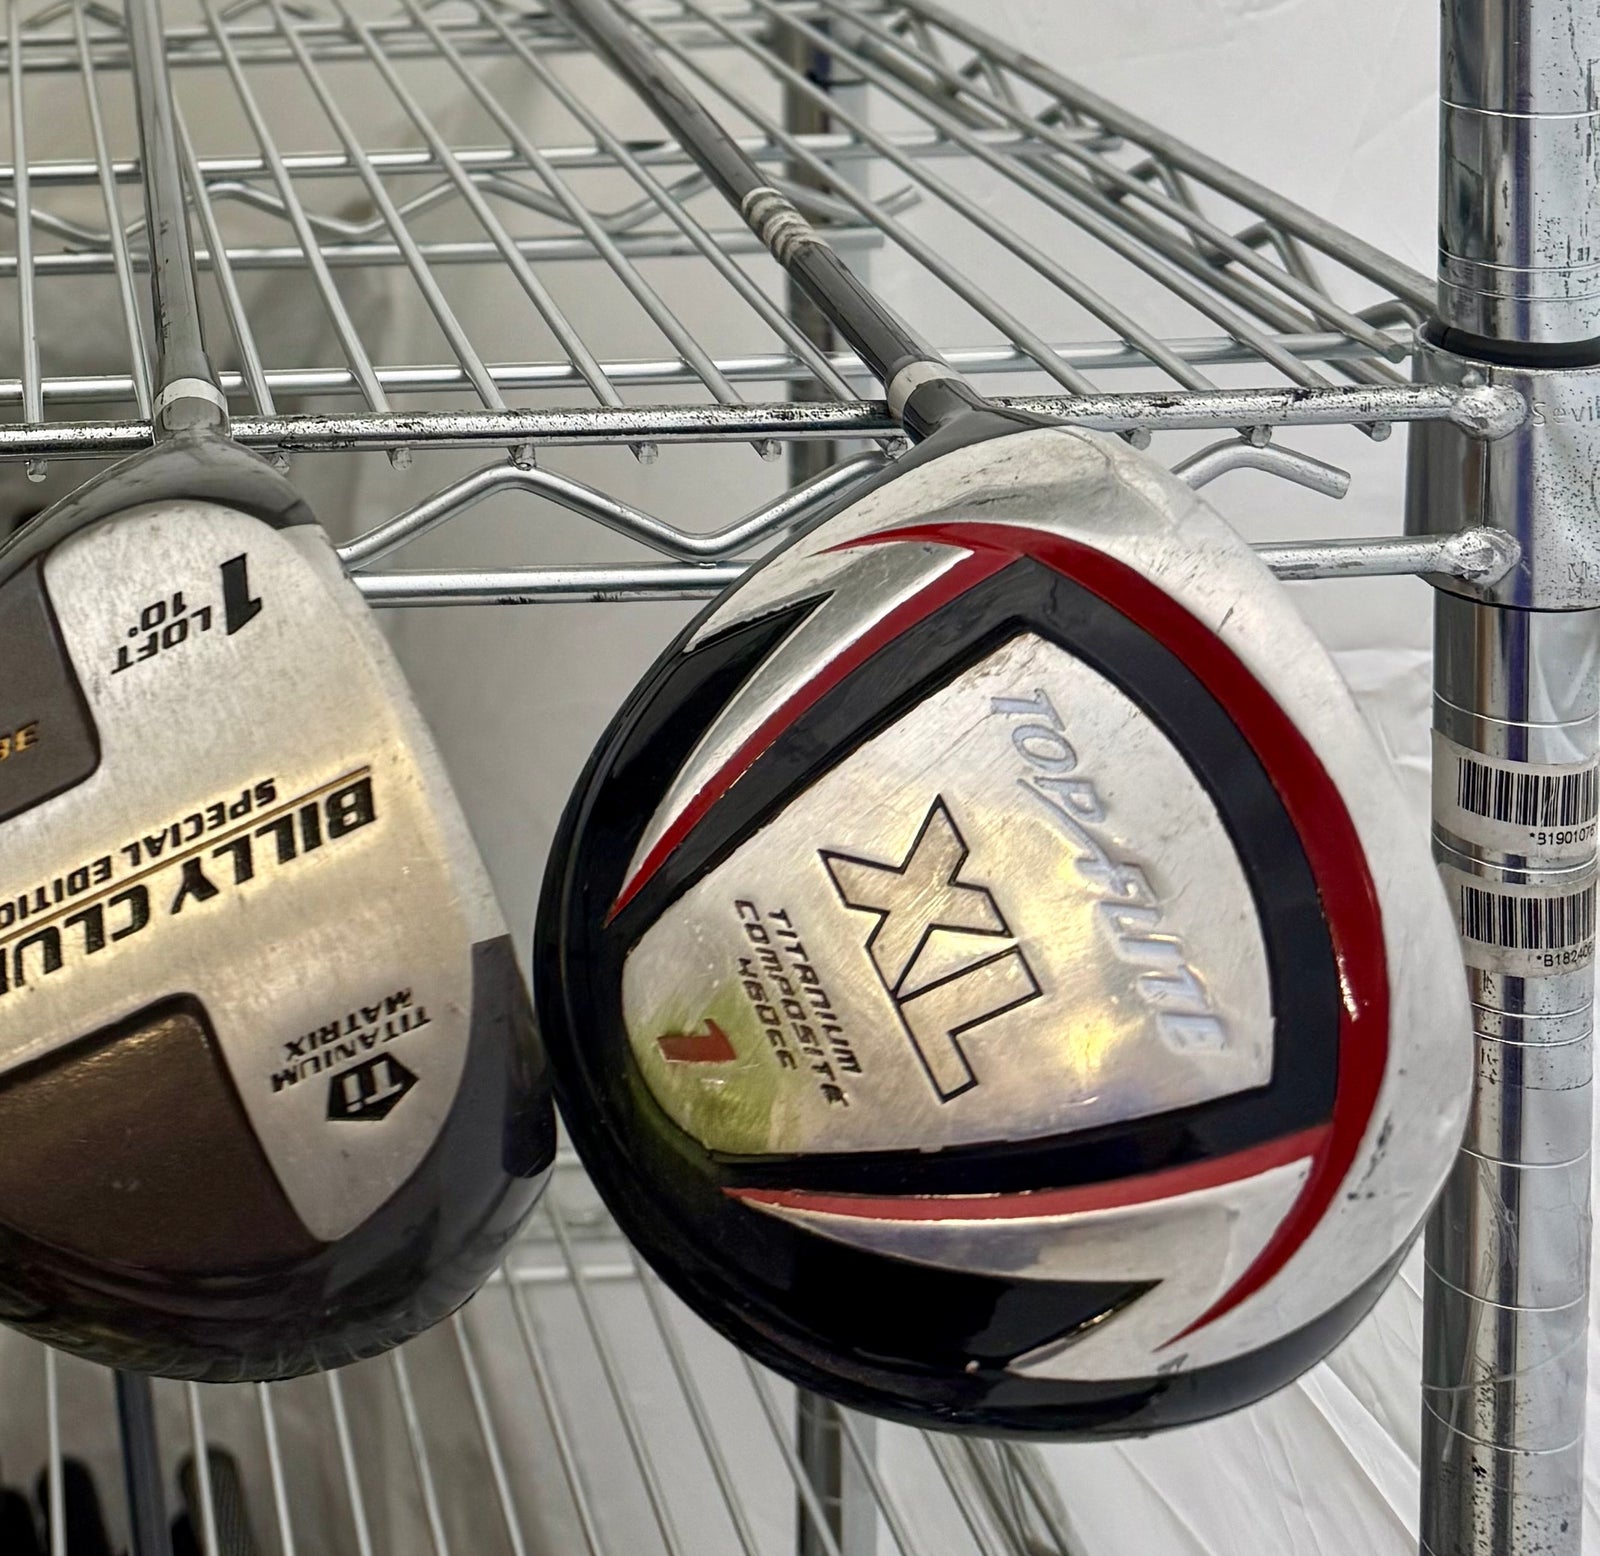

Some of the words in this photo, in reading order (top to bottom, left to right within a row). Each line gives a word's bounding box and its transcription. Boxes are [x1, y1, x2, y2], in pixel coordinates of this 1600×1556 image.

[220, 553, 262, 636] 1
[111, 605, 212, 675] LOFT
[990, 687, 1106, 824] TOP
[121, 777, 277, 868] SPECIAL
[169, 776, 379, 916] BILLY
[768, 908, 863, 1073] TITANIUM
[818, 793, 1044, 1104] XL
[283, 986, 414, 1062] MATRIX
[656, 1018, 738, 1064] 1
[734, 899, 850, 1107] COMPOSITE
[269, 1006, 432, 1093] TITANIUM
[342, 1059, 403, 1114] Ti
